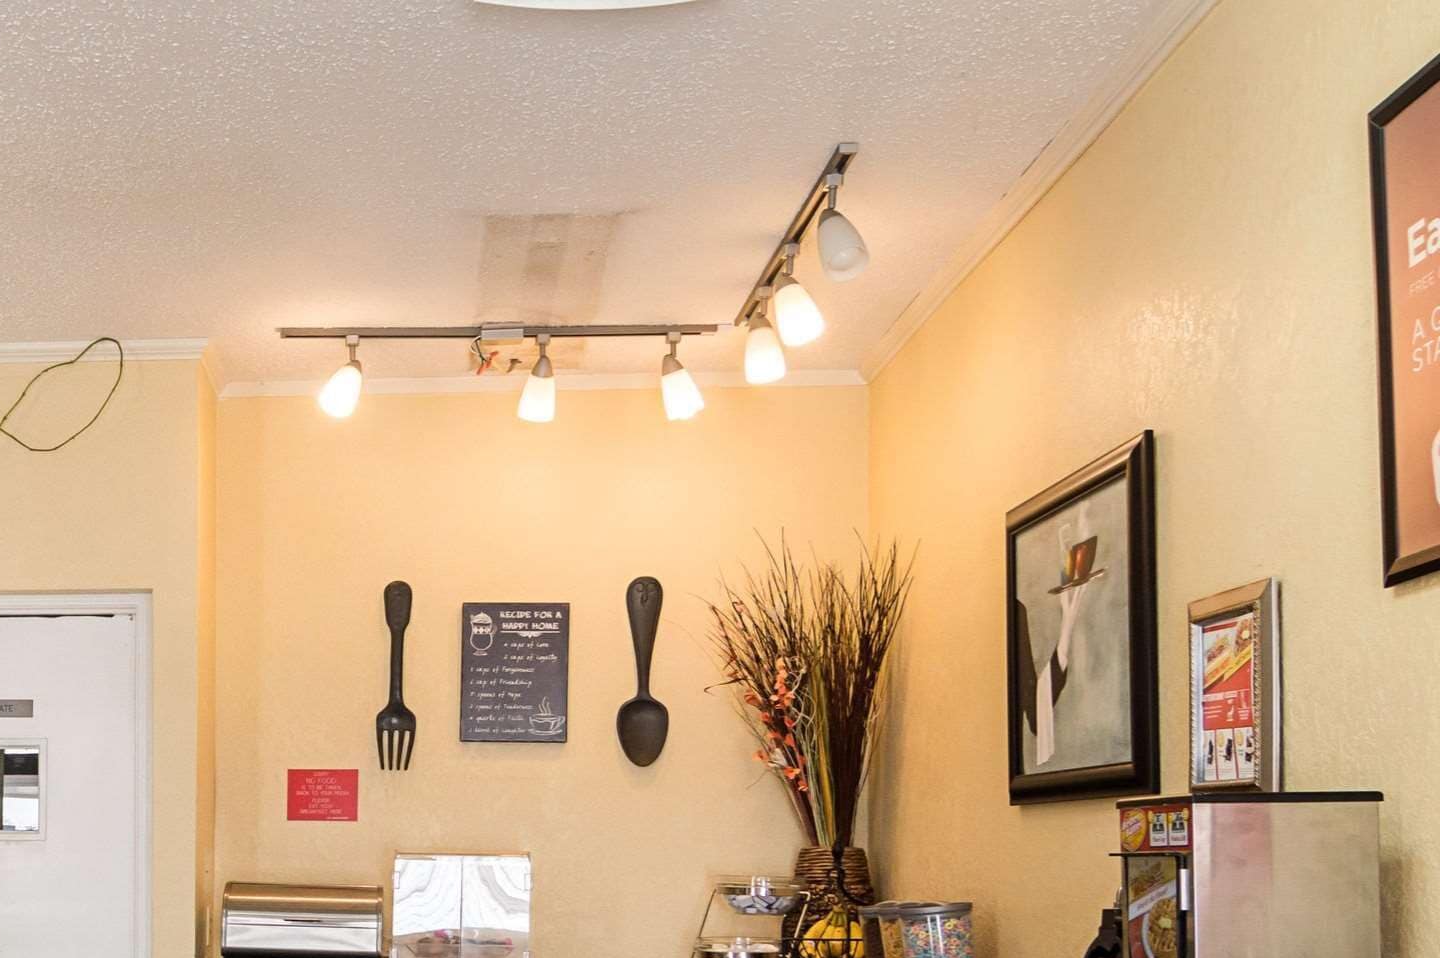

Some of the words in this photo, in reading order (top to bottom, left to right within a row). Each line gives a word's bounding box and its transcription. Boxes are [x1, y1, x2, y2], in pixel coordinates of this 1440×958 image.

[1412, 319, 1425, 344] A
[500, 611, 531, 619] RECIPE
[534, 611, 552, 619] FOR
[555, 611, 562, 619] A
[502, 622, 528, 630] HAPPY
[532, 622, 559, 630] HOME
[317, 777, 336, 785] FOOD
